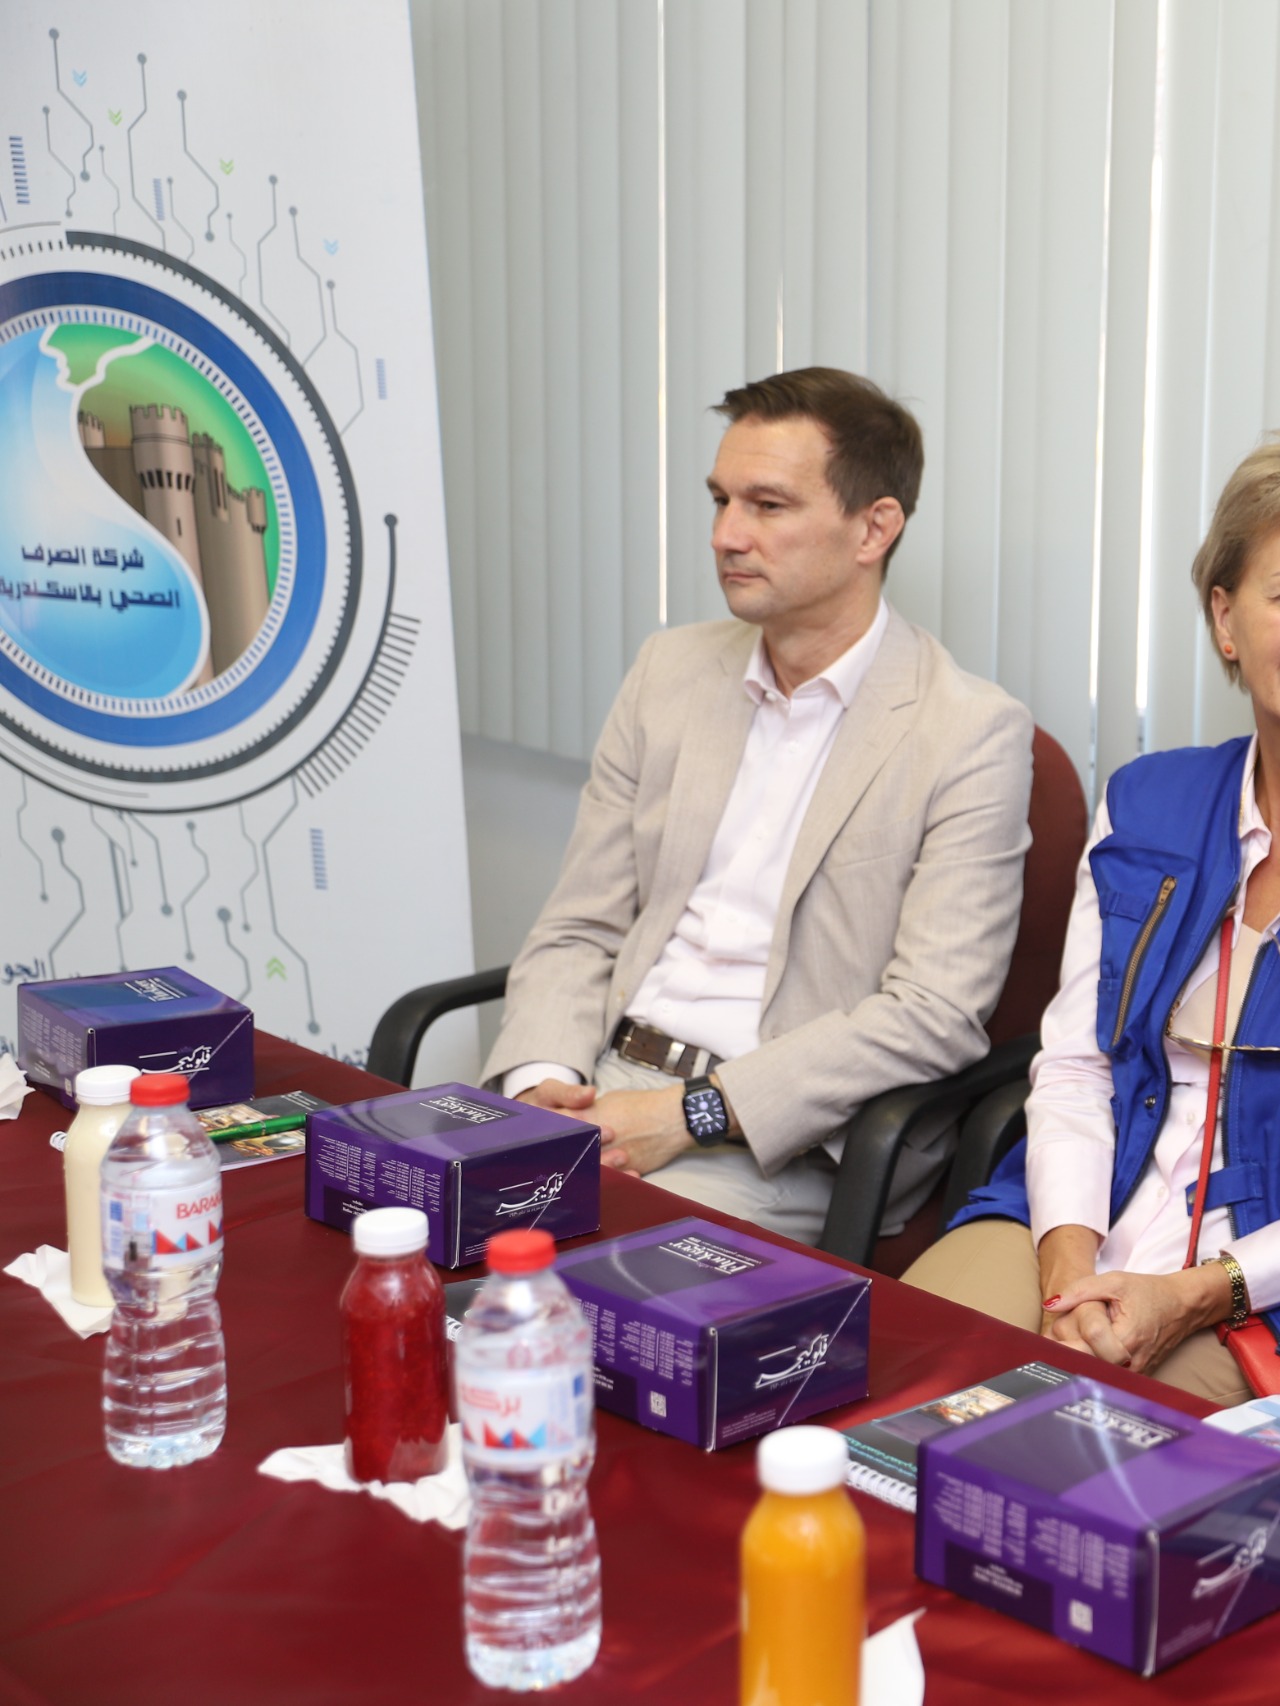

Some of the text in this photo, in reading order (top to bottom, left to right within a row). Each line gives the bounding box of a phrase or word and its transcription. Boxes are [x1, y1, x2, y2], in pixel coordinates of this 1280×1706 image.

[21, 543, 145, 572] شركة الصرف
[109, 588, 181, 613] الصحي
